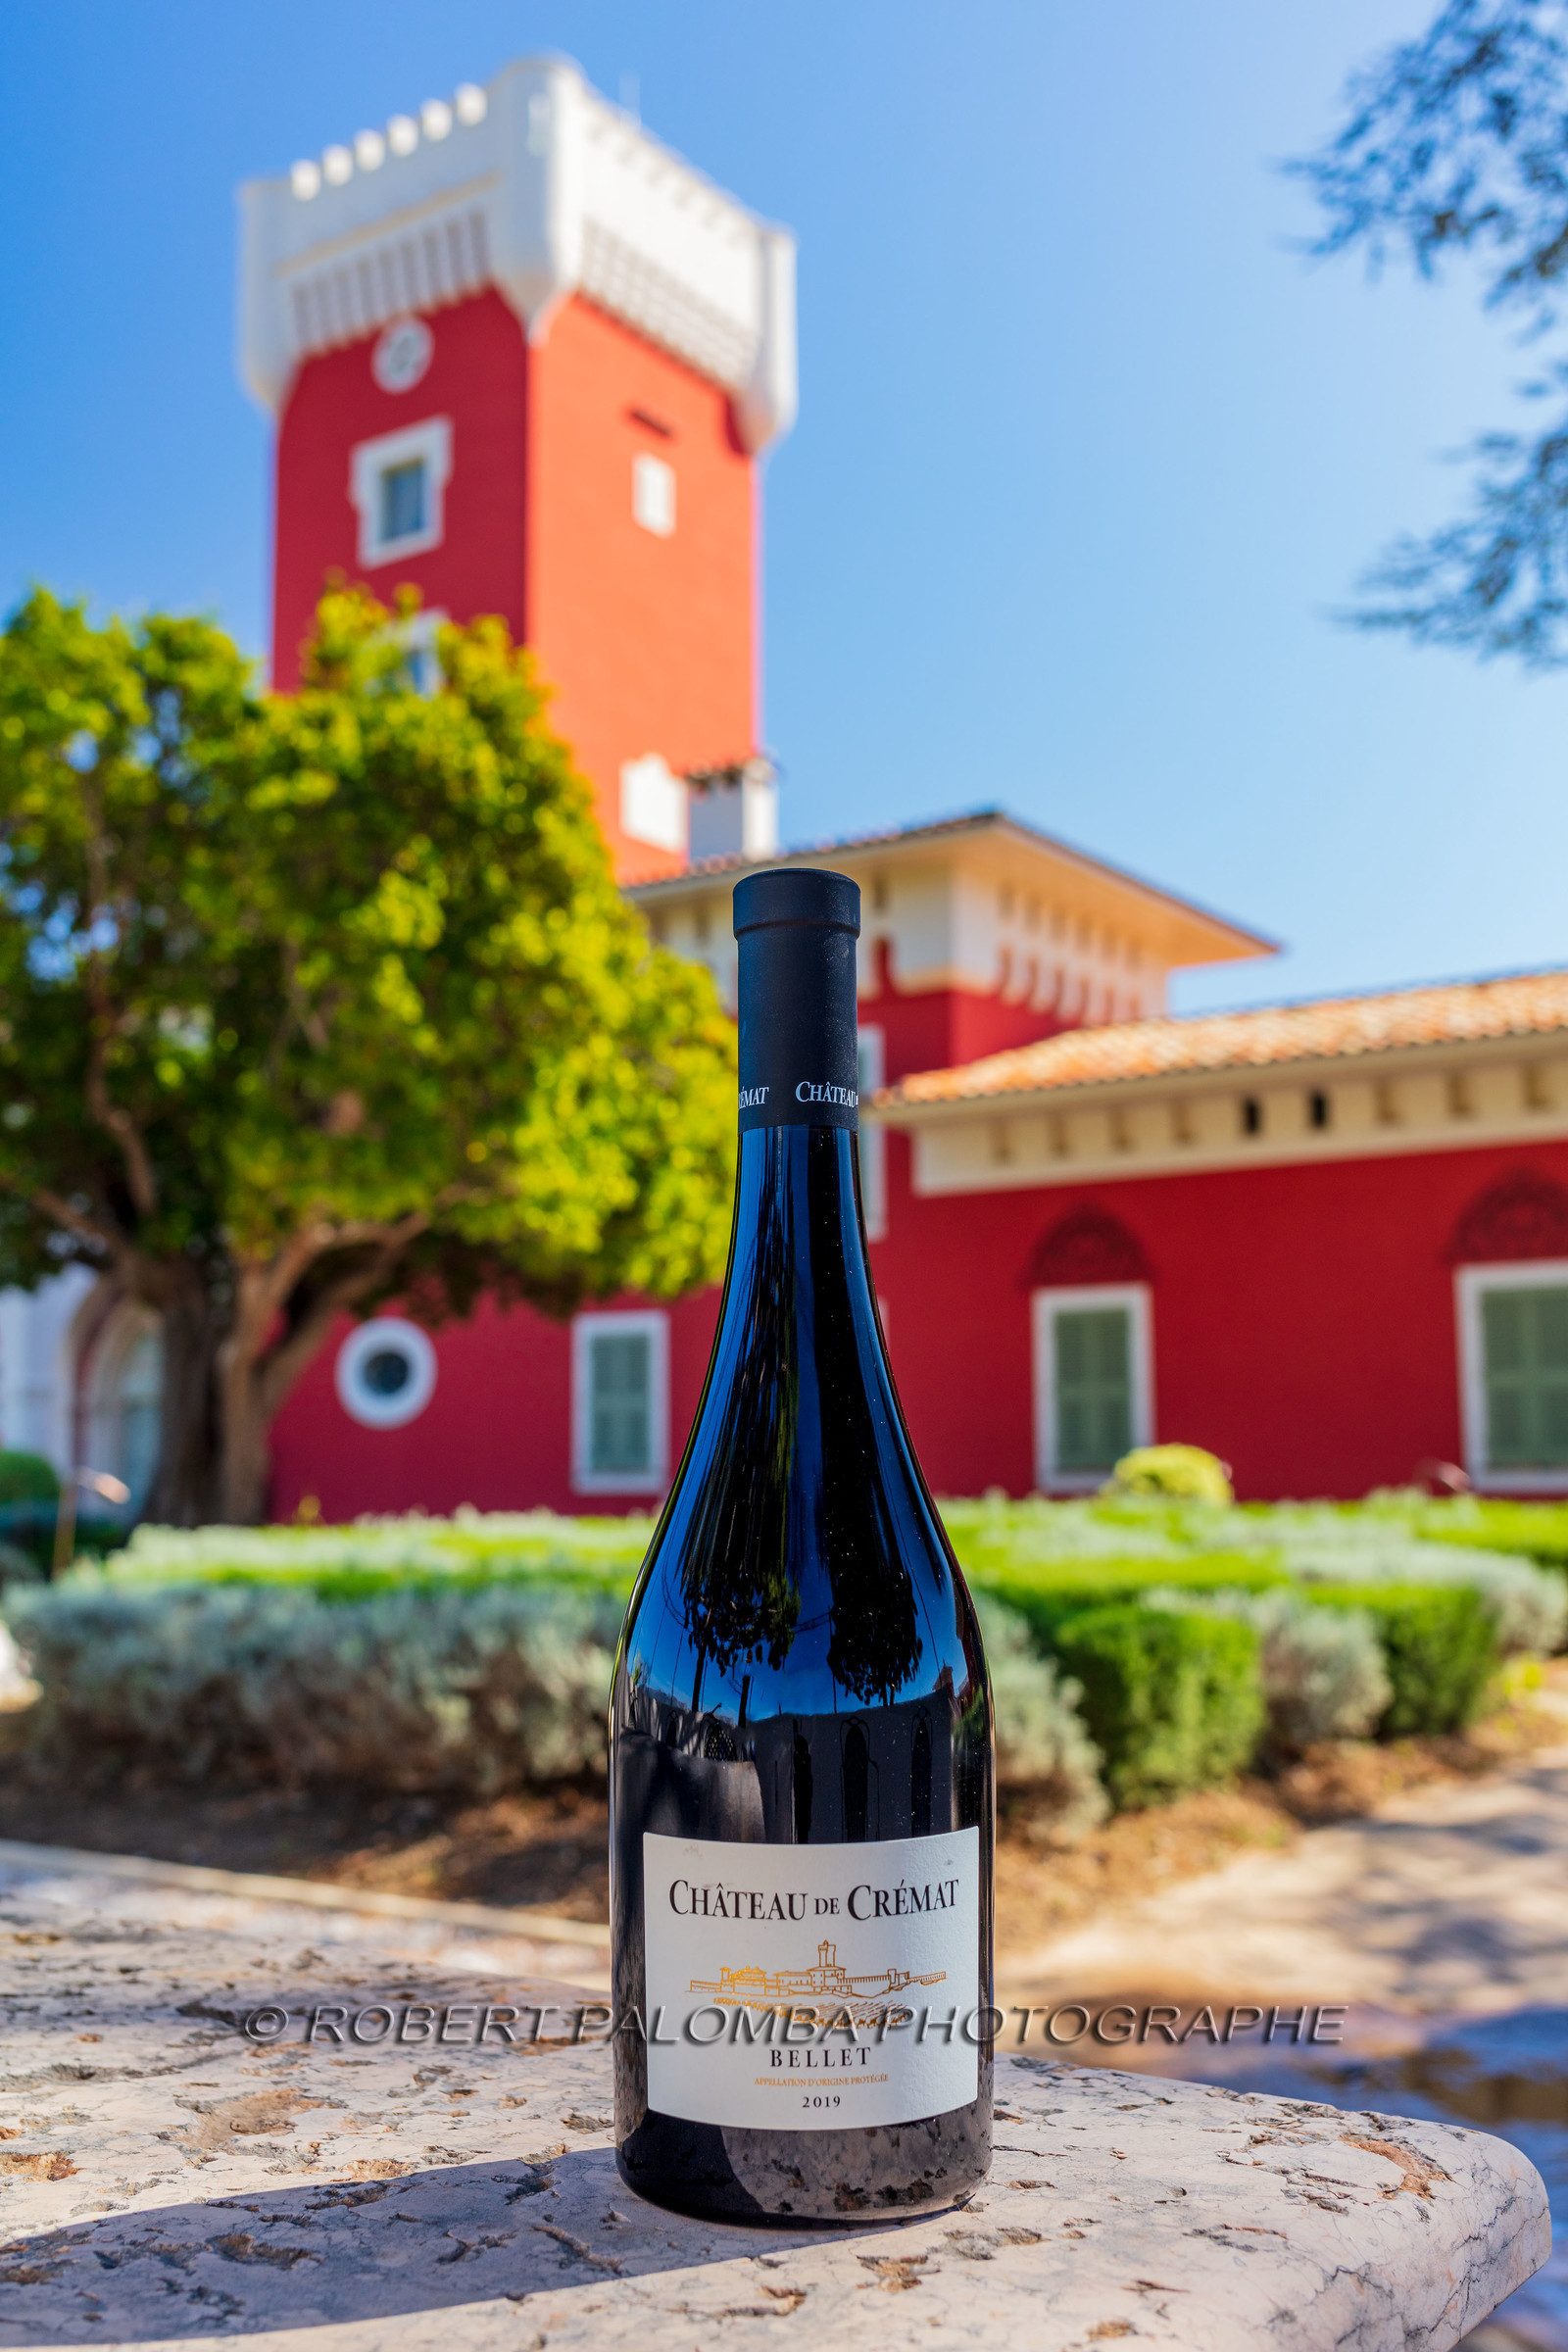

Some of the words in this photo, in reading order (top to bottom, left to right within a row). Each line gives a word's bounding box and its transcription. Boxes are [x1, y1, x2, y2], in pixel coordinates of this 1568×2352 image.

[795, 1081, 856, 1108] CHÂTEAU
[668, 1879, 808, 1921] CHÂTEAU
[814, 1897, 840, 1915] DE
[847, 1879, 959, 1921] CRÉMAT
[769, 2046, 871, 2068] BELLET
[754, 2077, 807, 2087] APPELLATION
[851, 2073, 889, 2085] PROTÉGÉE
[802, 2095, 841, 2108] 2019
